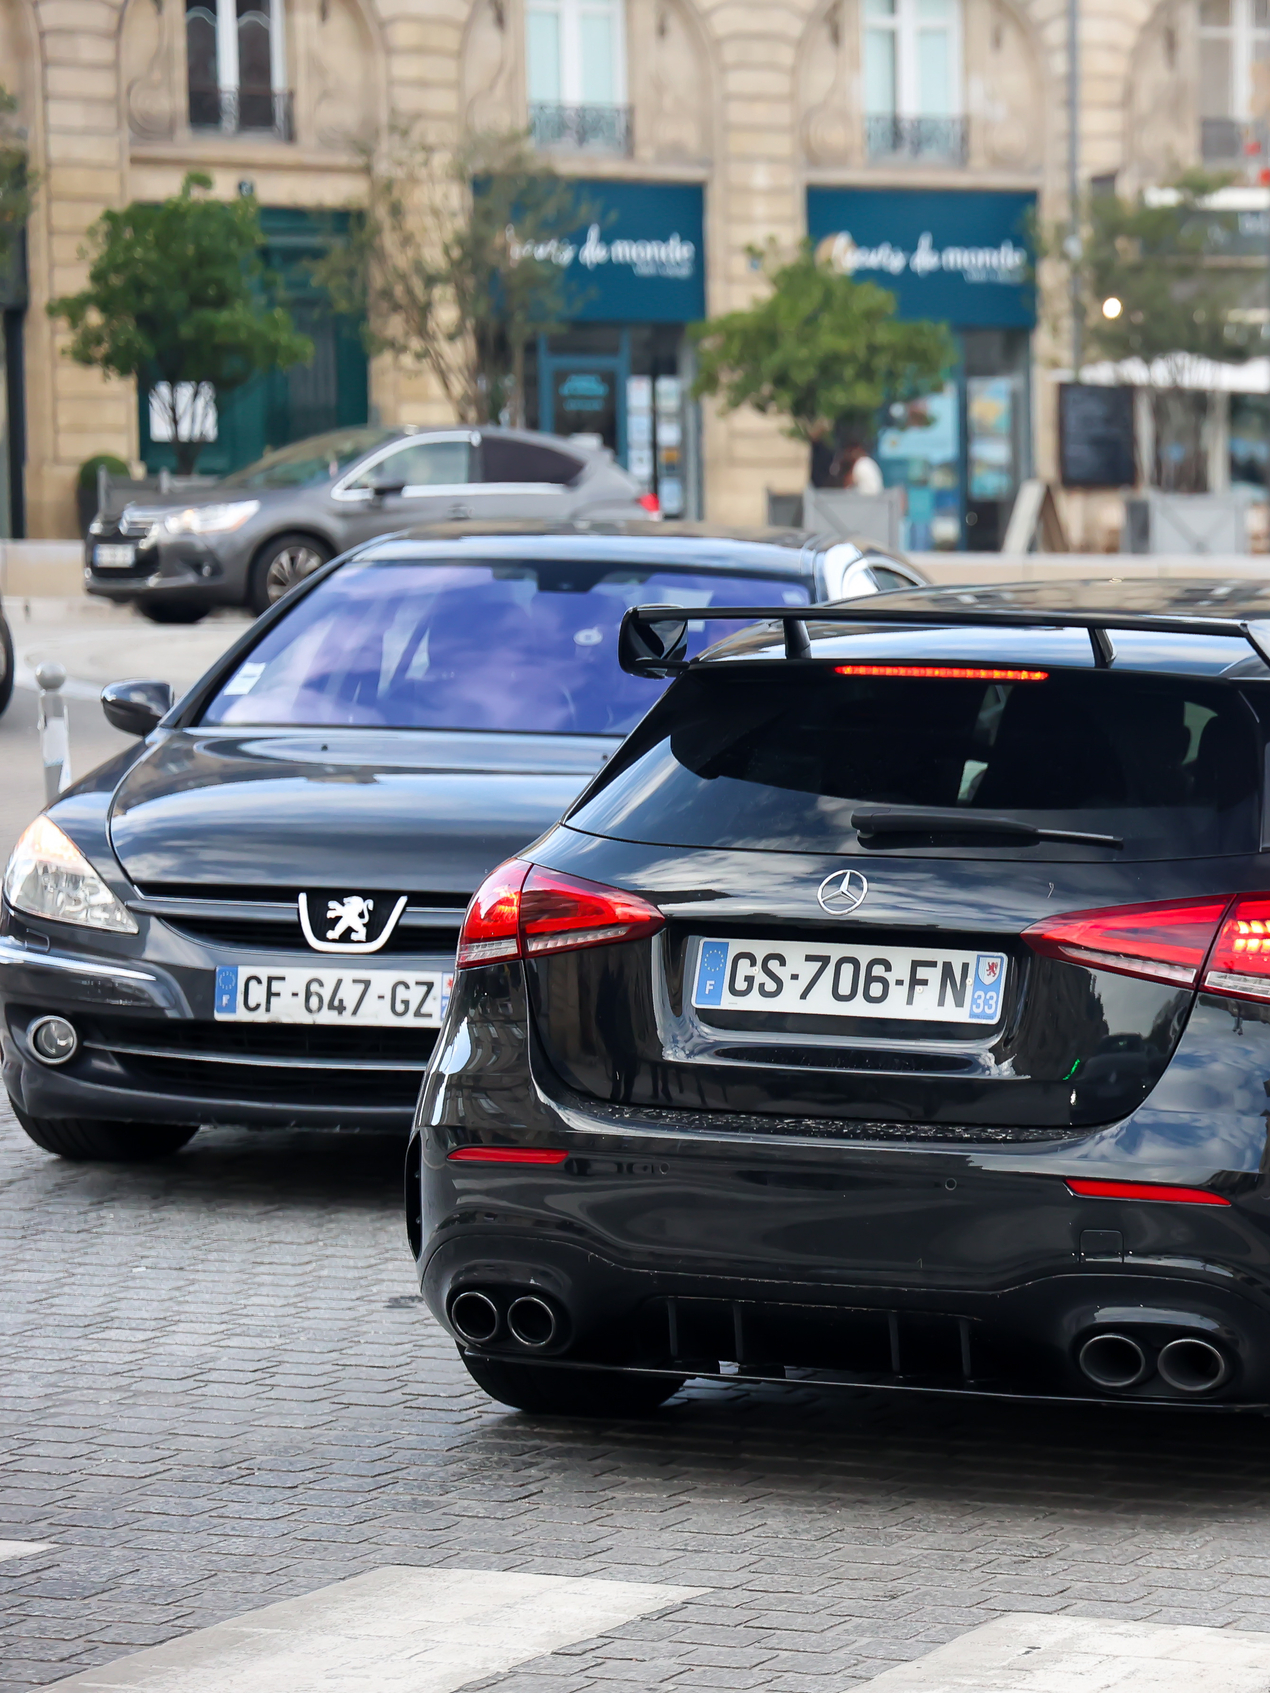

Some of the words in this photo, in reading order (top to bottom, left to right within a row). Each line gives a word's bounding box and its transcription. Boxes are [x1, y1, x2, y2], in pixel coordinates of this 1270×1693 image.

[611, 232, 695, 264] monde
[942, 239, 1027, 271] monde
[705, 980, 715, 995] F
[728, 951, 970, 1008] GS-706-FN
[221, 994, 230, 1008] F
[243, 975, 435, 1018] CF-647-GZ
[972, 990, 997, 1014] 33
